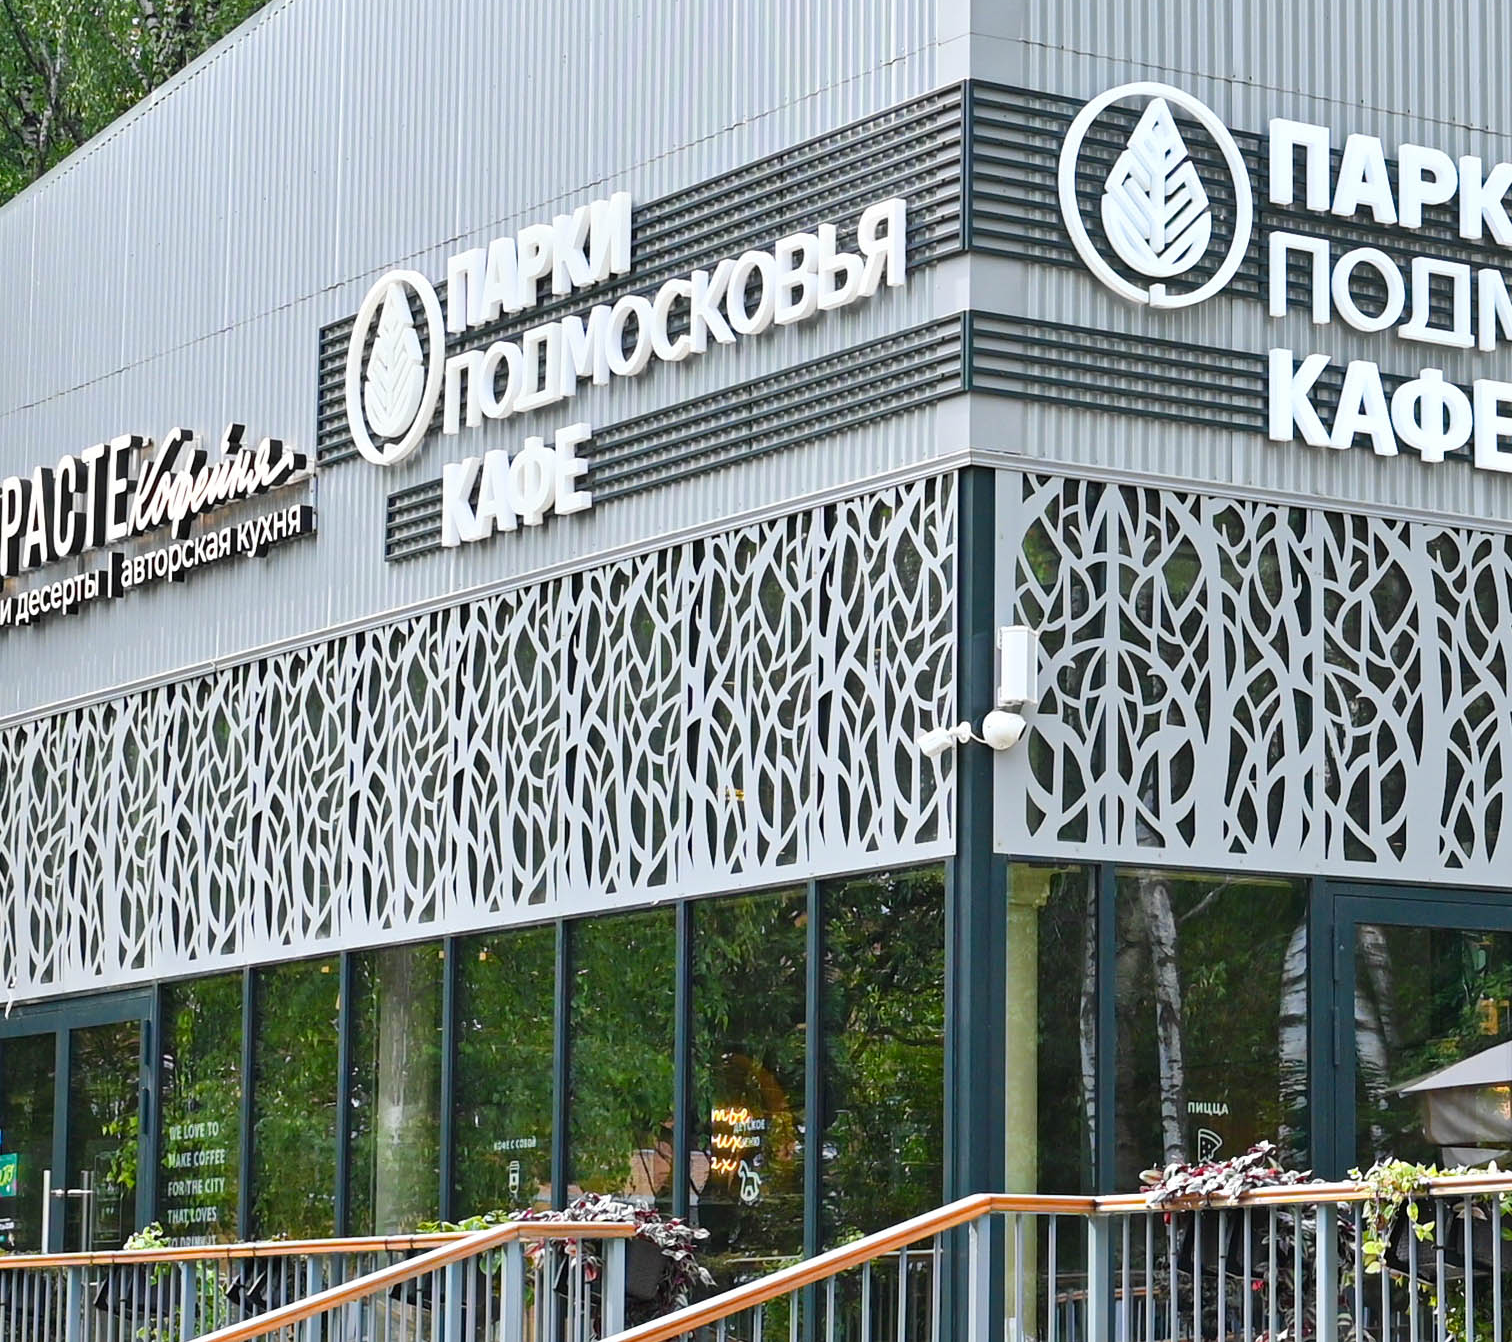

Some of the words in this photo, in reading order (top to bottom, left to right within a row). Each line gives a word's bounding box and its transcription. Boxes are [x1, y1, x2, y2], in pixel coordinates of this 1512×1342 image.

[446, 192, 632, 334] ПАРКИ
[443, 197, 907, 436] ПОДМОСКОВЬЯ
[128, 423, 295, 539] Кофейня
[441, 423, 593, 549] КАФЕ
[0, 601, 13, 626] и
[15, 569, 100, 626] десерты
[120, 526, 231, 583] авторская
[236, 504, 302, 559] кухня
[169, 1125, 182, 1141] WE
[183, 1122, 205, 1140] LOVE
[208, 1121, 219, 1137] TO
[1188, 1101, 1229, 1116] ПИЦЦА
[167, 1180, 185, 1197] FOR
[187, 1178, 203, 1195] THE
[204, 1176, 226, 1193] CITY
[168, 1151, 192, 1168] MAKE
[193, 1148, 226, 1167] COFFEE
[189, 1205, 217, 1223] LOVES
